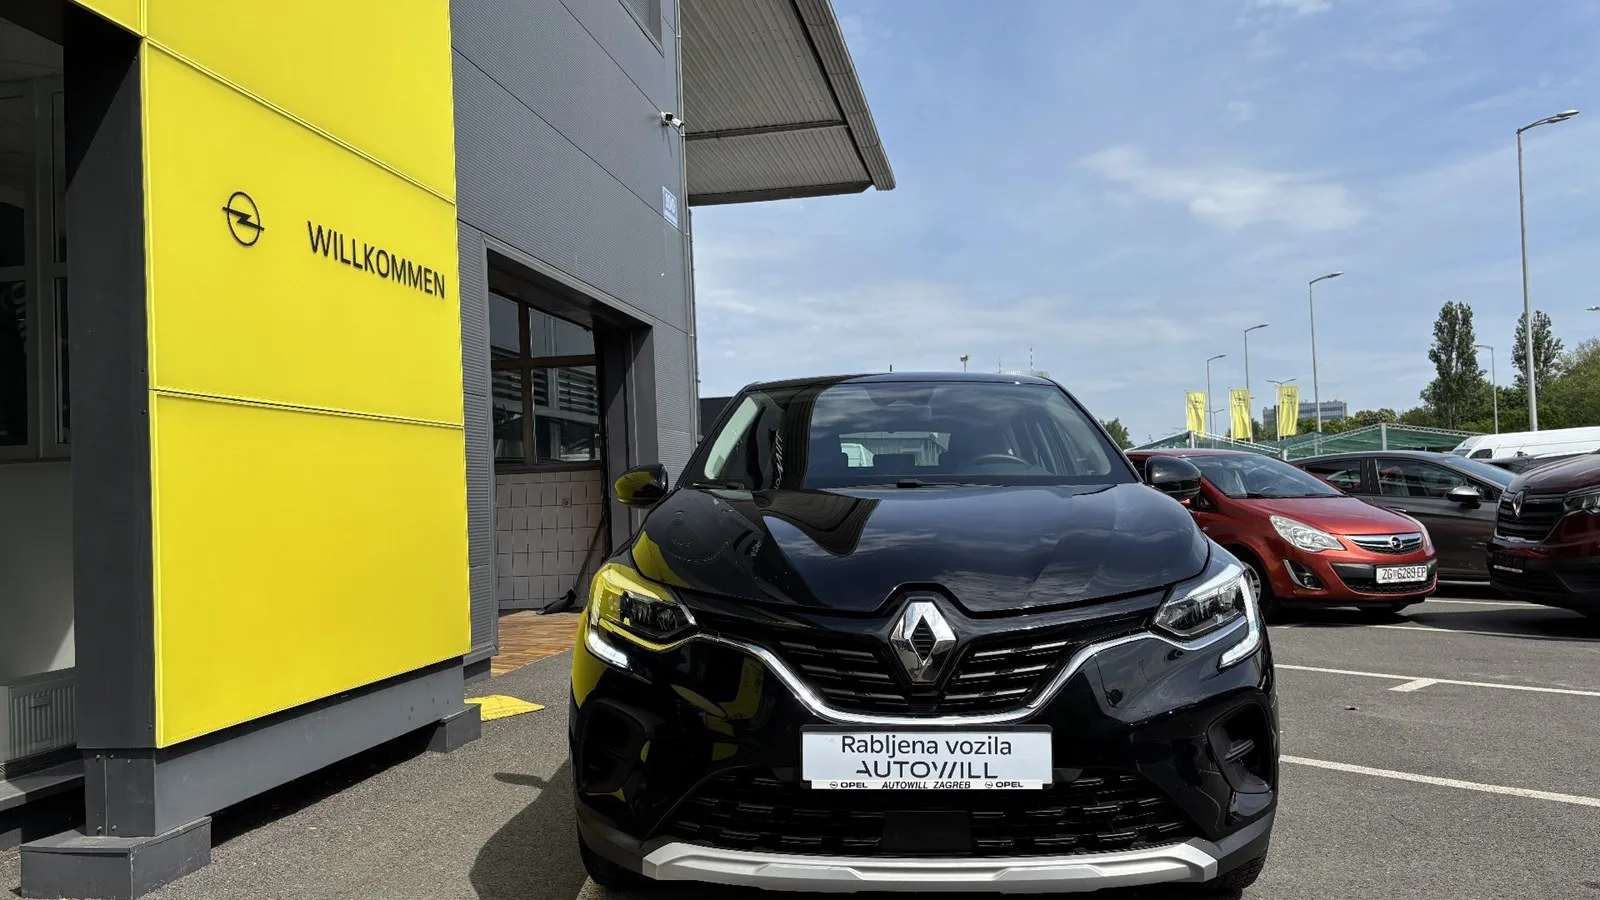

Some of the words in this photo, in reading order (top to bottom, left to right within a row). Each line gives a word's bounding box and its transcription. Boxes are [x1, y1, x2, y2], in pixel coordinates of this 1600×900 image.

[307, 220, 445, 299] WILLKOMMEN
[1382, 569, 1393, 580] ZG
[841, 734, 938, 758] Rabljena
[945, 735, 1012, 755] vozila
[855, 760, 998, 779] AUTOWILL
[881, 781, 928, 789] AUTOWILL
[933, 781, 971, 789] ZAGREB
